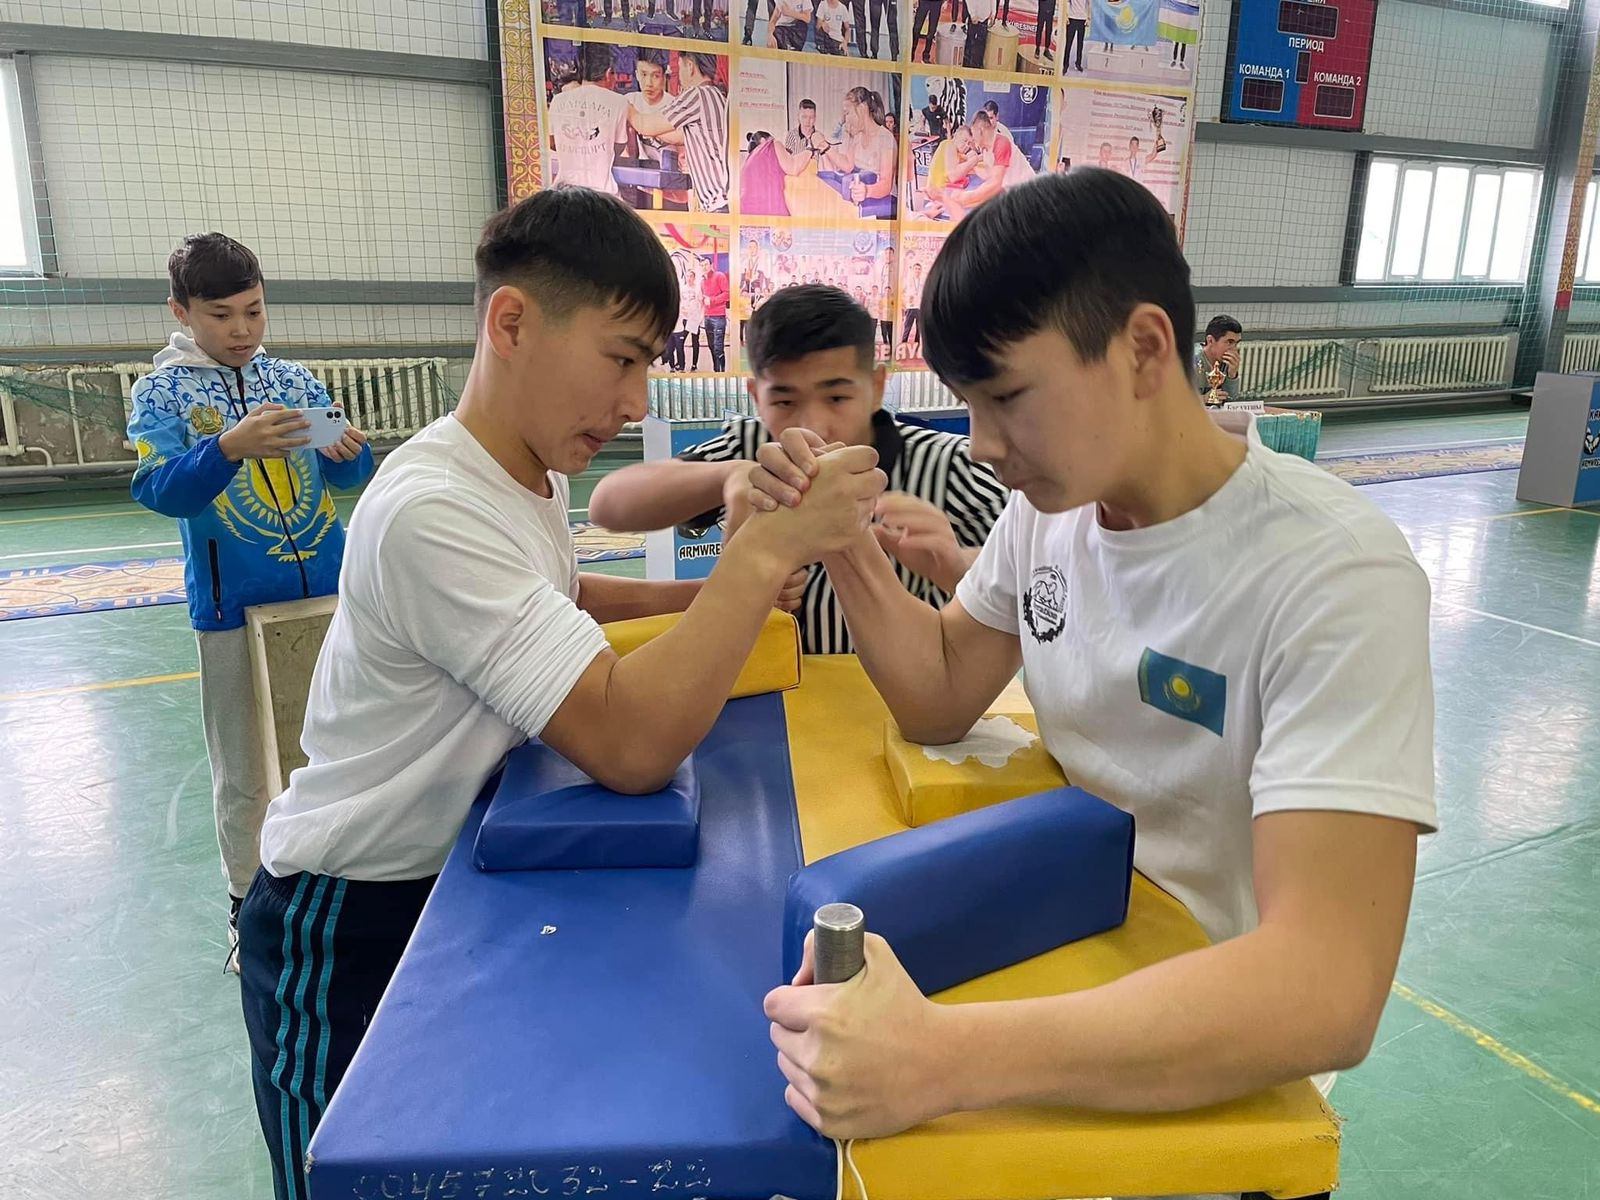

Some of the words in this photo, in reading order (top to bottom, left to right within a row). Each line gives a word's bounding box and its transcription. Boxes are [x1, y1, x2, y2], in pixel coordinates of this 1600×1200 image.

[1288, 37, 1325, 52] ПЕРИОД
[1239, 63, 1283, 79] КОМАНДА
[1285, 69, 1290, 78] 1
[1314, 71, 1355, 86] КОМАНДА
[1355, 76, 1361, 86] 2
[679, 543, 723, 560] ARMWRE
